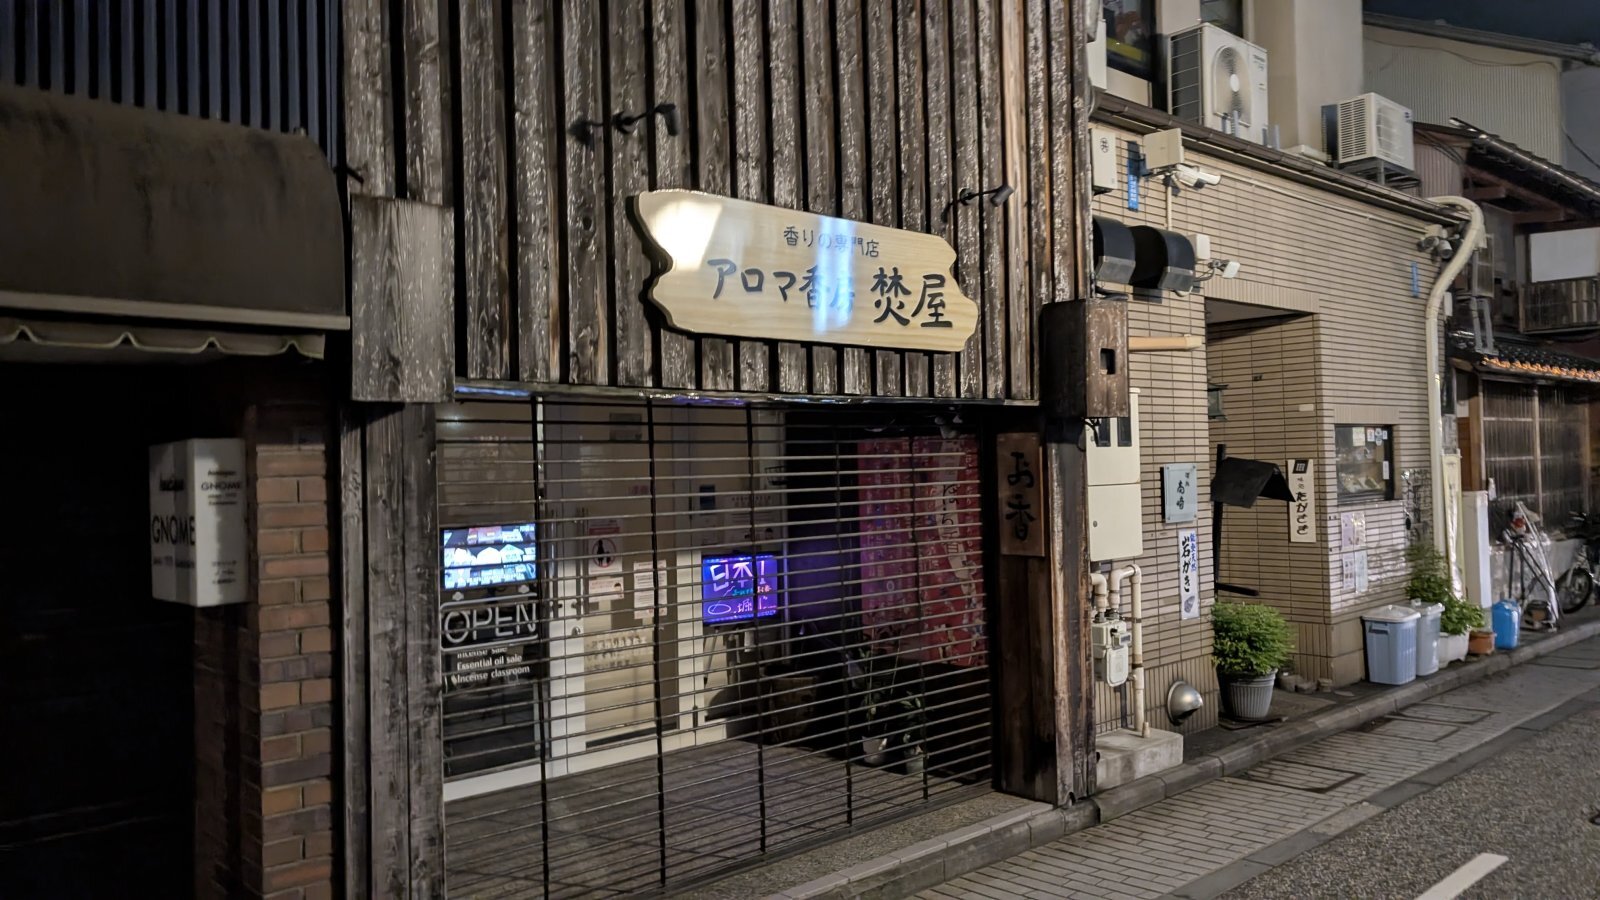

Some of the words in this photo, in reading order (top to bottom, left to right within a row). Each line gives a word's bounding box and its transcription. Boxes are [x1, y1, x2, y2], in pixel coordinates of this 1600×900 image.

[784, 225, 879, 258] 香りの専門店
[870, 266, 952, 328] 焚屋
[1005, 451, 1036, 541] お香
[152, 515, 195, 546] GNOME
[1181, 536, 1191, 593] 岩がき
[444, 602, 536, 644] OPEN
[457, 657, 492, 671] Essential
[494, 655, 504, 665] oil
[506, 653, 522, 664] sale
[457, 672, 488, 684] Incense
[491, 665, 530, 679] classroom
